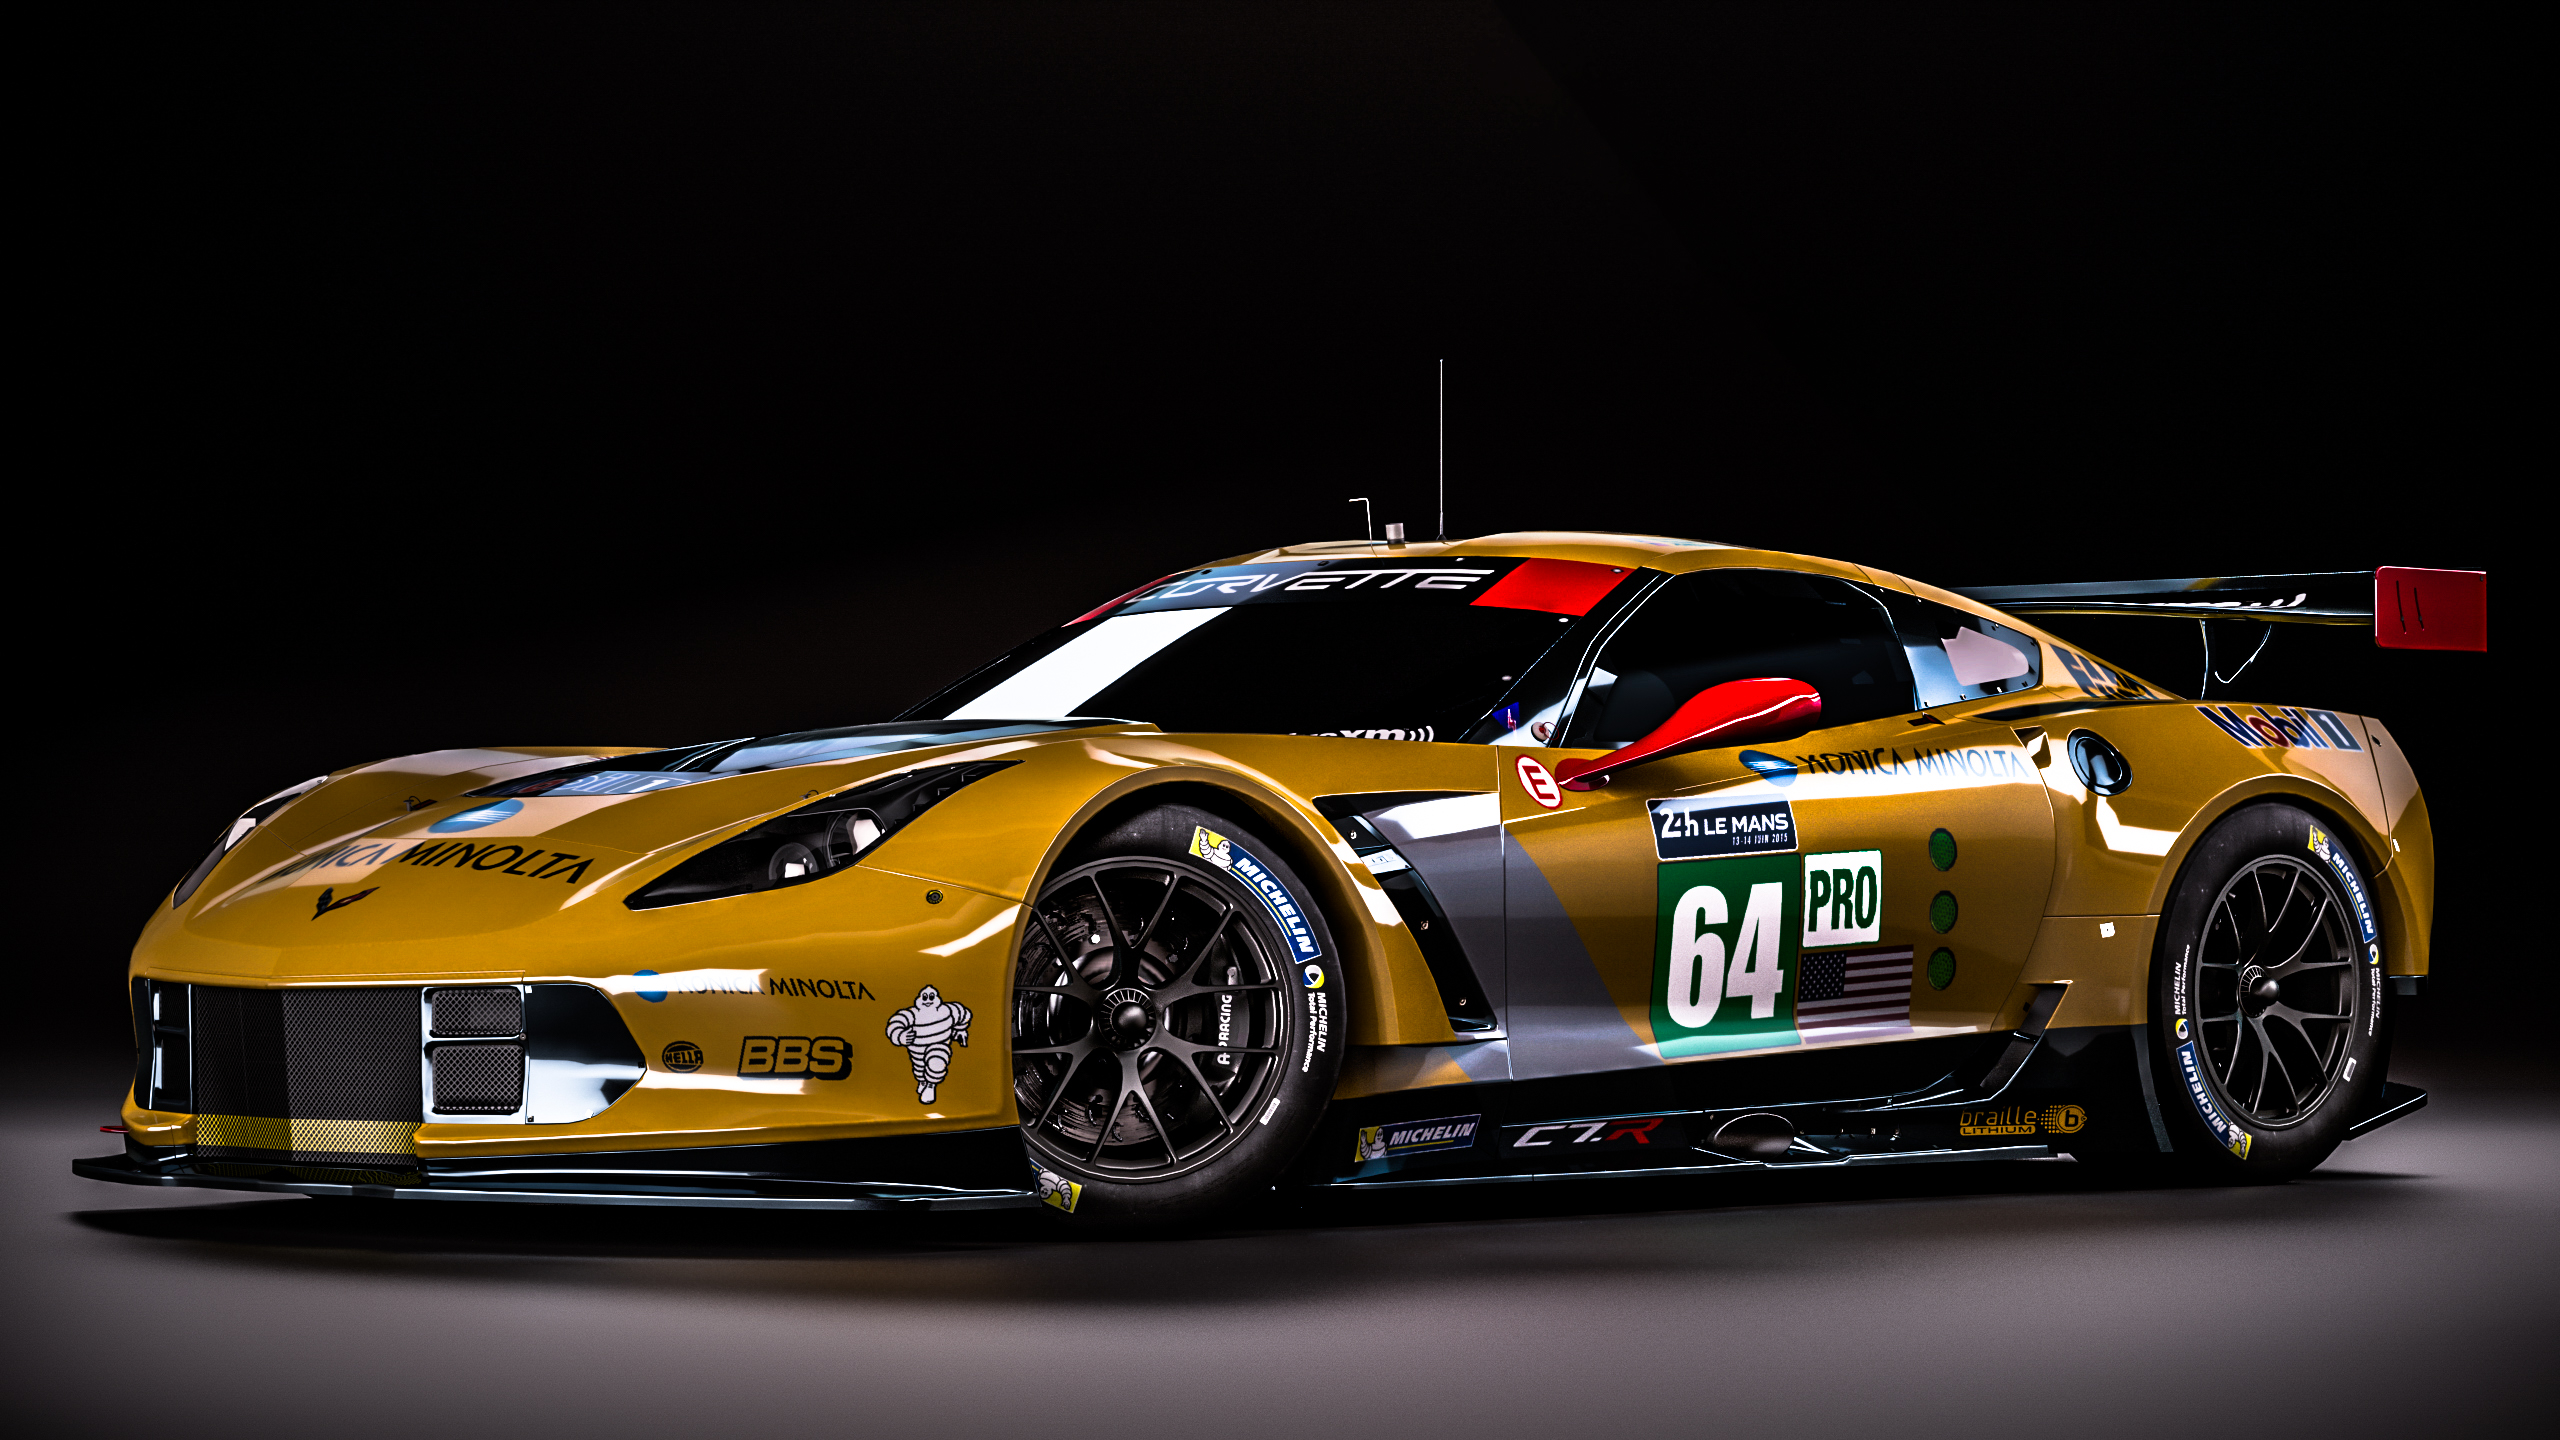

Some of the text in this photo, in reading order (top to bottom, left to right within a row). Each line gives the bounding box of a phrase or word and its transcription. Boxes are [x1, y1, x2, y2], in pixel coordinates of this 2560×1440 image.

[1125, 569, 1495, 603] CORVETTE
[2194, 706, 2330, 749] Mobil
[1914, 748, 2030, 778] MINOLTA
[1704, 818, 1728, 836] LE
[1732, 813, 1788, 833] MANS
[381, 841, 596, 885] MINOLTA
[1235, 857, 1314, 953] MICHELIN
[1808, 866, 1878, 933] PRO
[2333, 852, 2374, 934] MICHELIN
[1667, 881, 1784, 1028] 64
[770, 977, 876, 1001] MINOLTA
[1308, 992, 1318, 1014] Total
[2174, 962, 2182, 1016] MICHELIN
[1218, 994, 1233, 1041] RACING
[1317, 992, 1328, 1053] MICHELIN
[665, 1050, 704, 1065] HELLA
[737, 1036, 853, 1080] BBS
[2181, 1051, 2227, 1134] MICHELIN
[1388, 1121, 1476, 1146] MICHELIN
[1513, 1117, 1664, 1148] C7.R
[1960, 1105, 2037, 1126] braille
[1962, 1126, 2033, 1135] LITHIUM
